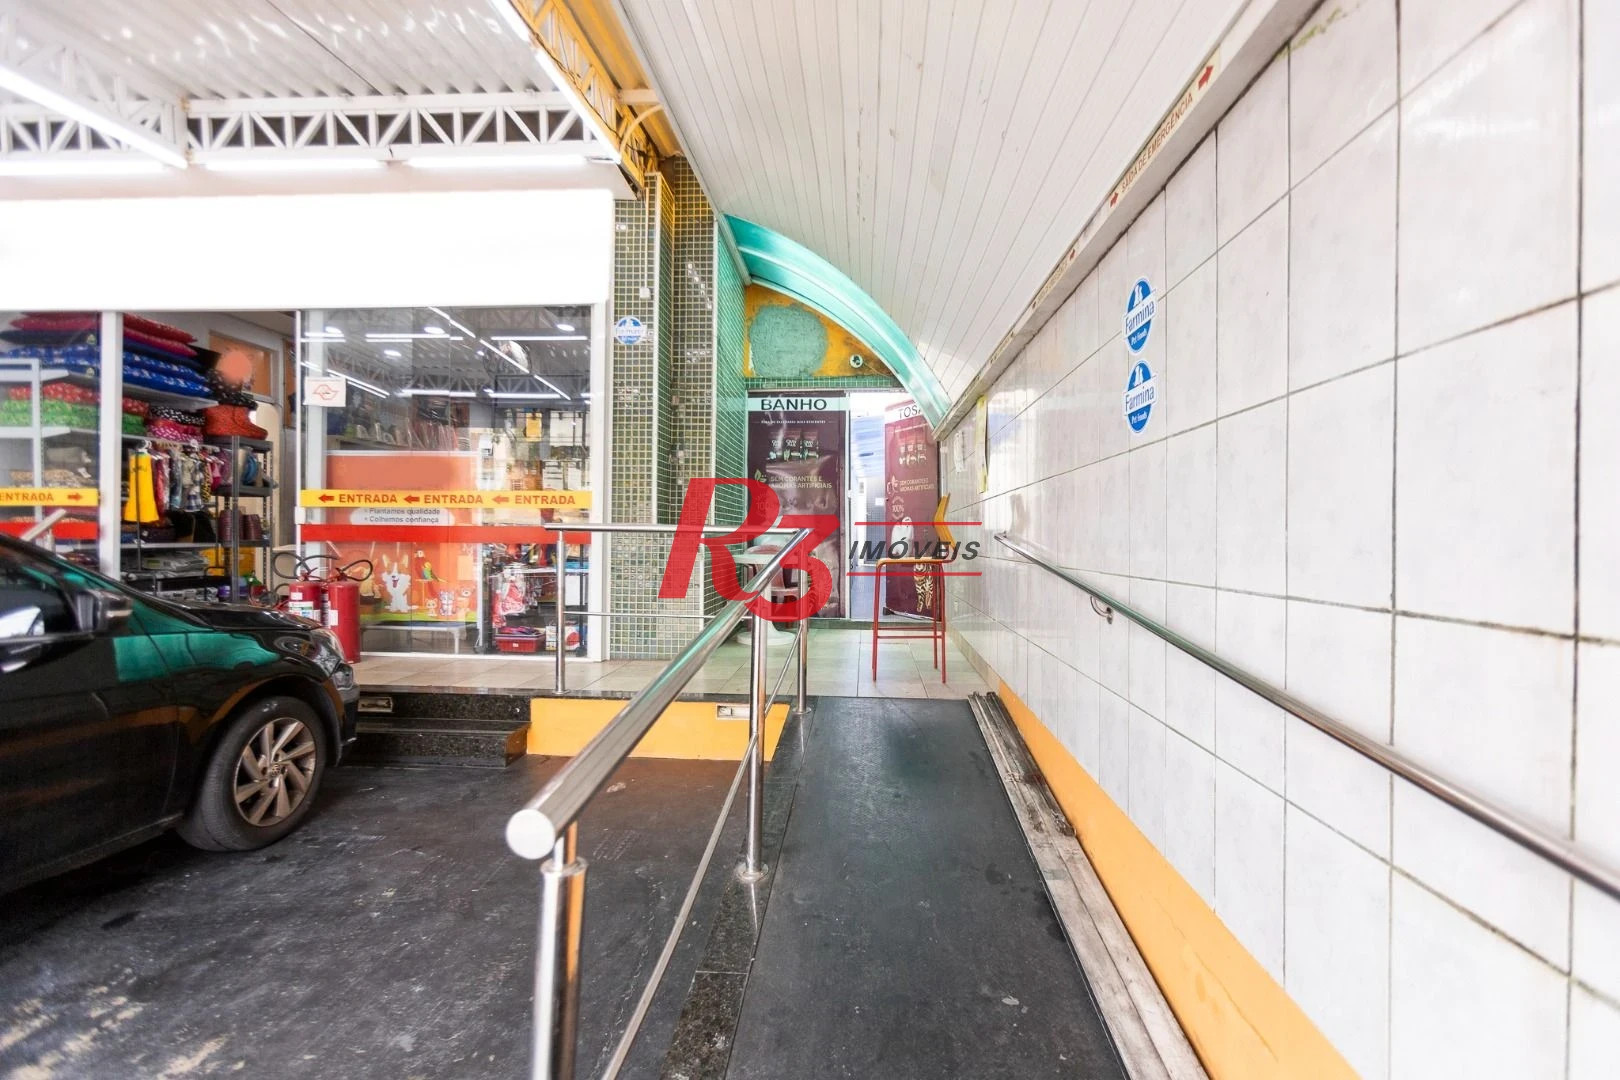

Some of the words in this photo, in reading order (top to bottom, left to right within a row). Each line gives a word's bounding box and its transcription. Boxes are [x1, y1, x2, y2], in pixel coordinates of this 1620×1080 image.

[1138, 153, 1148, 172] DE
[1125, 300, 1155, 335] Farmina
[761, 398, 827, 411] BANHO
[1125, 385, 1156, 413] Farmina
[0, 492, 54, 502] ENTRADA
[338, 493, 398, 504] ENTRADA
[423, 494, 484, 505] ENTRADA
[514, 495, 576, 505] ENTRADA
[369, 507, 405, 515] Plantamos
[406, 507, 440, 517] qualidade
[369, 515, 404, 523] Colhemos
[405, 515, 439, 525] confiança
